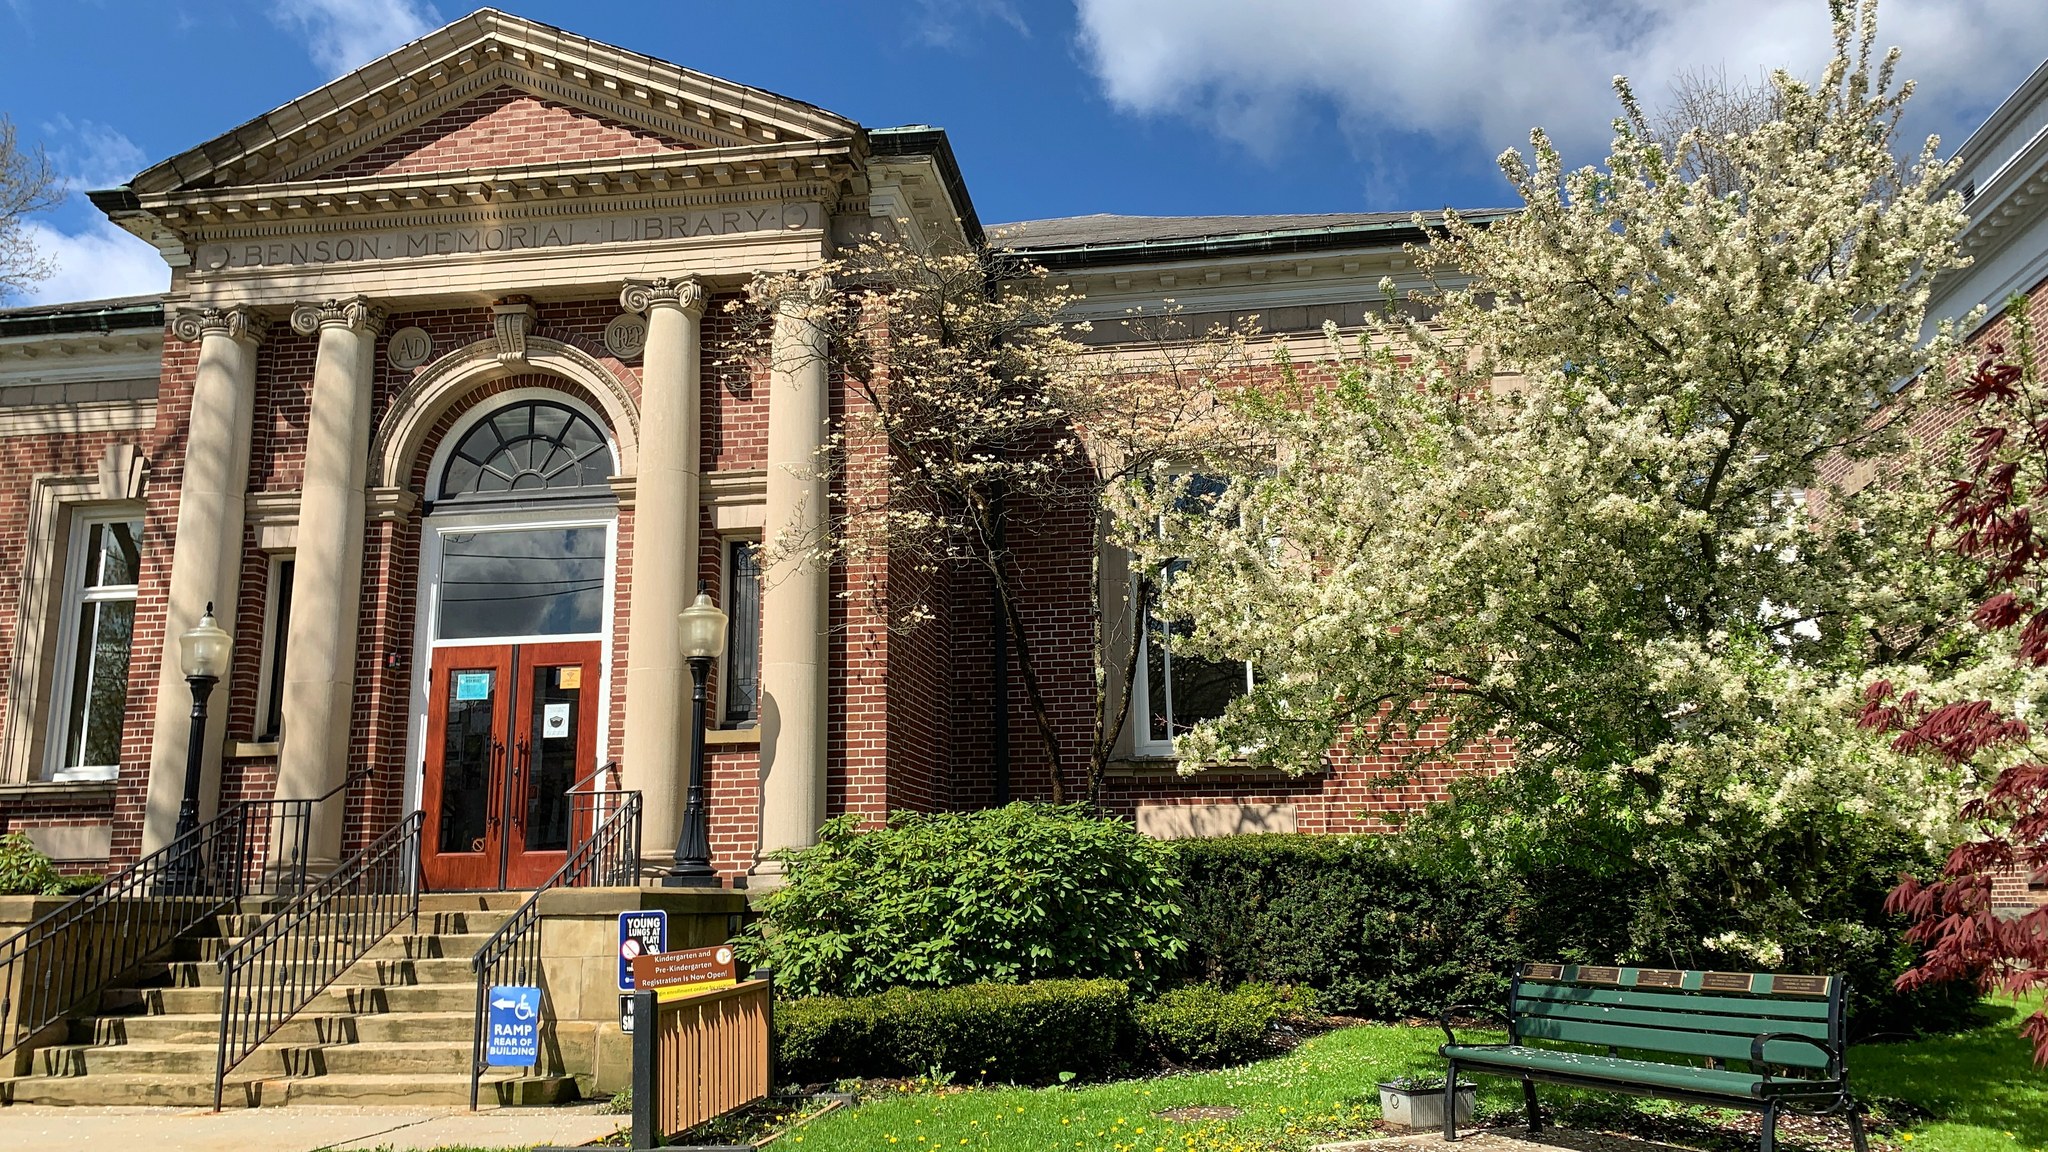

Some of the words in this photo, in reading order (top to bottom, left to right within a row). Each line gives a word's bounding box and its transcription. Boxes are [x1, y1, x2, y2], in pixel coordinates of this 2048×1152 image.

[243, 236, 380, 266] BENSON
[405, 223, 587, 257] MEMORIAL
[611, 208, 769, 242] LIBRARY
[627, 917, 660, 929] YOUNG
[629, 928, 651, 937] LUNGS
[652, 927, 661, 936] AT
[654, 951, 698, 963] Kindergarten
[698, 950, 711, 958] and
[655, 962, 712, 974] Pre-Kindergarten
[642, 976, 682, 987] Registration
[690, 973, 706, 981] Now
[706, 970, 728, 980] Open!
[627, 999, 635, 1015] N
[494, 1023, 533, 1036] RAMP
[494, 1037, 517, 1046] REAR
[520, 1038, 532, 1047] OF
[489, 1046, 535, 1056] BUILDING
